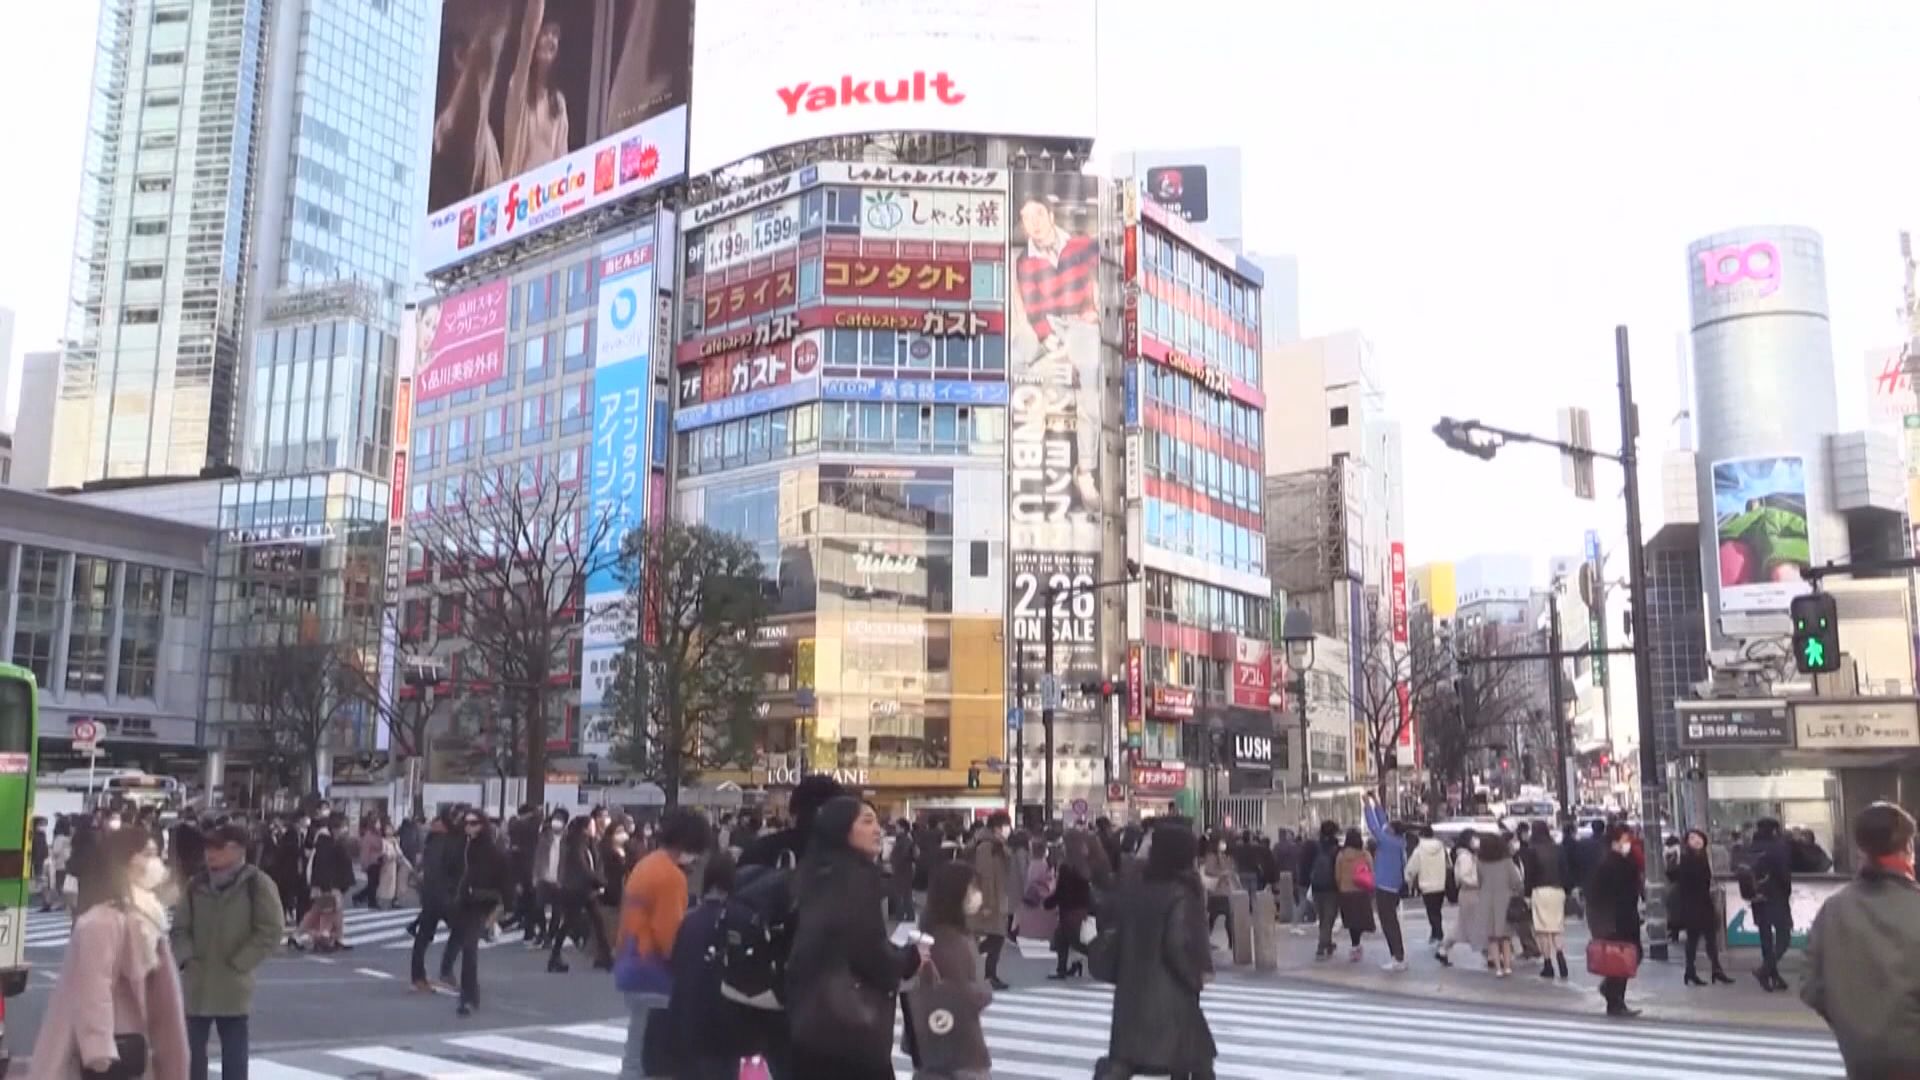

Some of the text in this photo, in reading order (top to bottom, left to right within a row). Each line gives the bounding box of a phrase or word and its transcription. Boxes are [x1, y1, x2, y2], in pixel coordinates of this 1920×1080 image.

[776, 70, 967, 115] Yakult
[847, 165, 998, 187] しゃぶしゃぶバイキング
[912, 199, 999, 228] しゃぶ葉
[688, 242, 705, 264] 9F
[825, 261, 966, 290] コンタクト
[456, 288, 503, 315] 品川スキン
[456, 310, 497, 333] クリニック
[754, 314, 800, 345] ガスト
[923, 309, 988, 336] ガスト
[428, 350, 498, 391] 品川美容外科
[731, 353, 786, 393] ガスト
[1204, 367, 1232, 396] ガスト
[682, 376, 701, 399] 7F
[595, 391, 622, 553] アイシティ
[1014, 573, 1096, 619] 2.26
[1014, 618, 1095, 642] ON SALE
[1240, 665, 1264, 688] アコム
[1235, 735, 1272, 760] LUSH
[768, 767, 870, 785] L'OCANE
